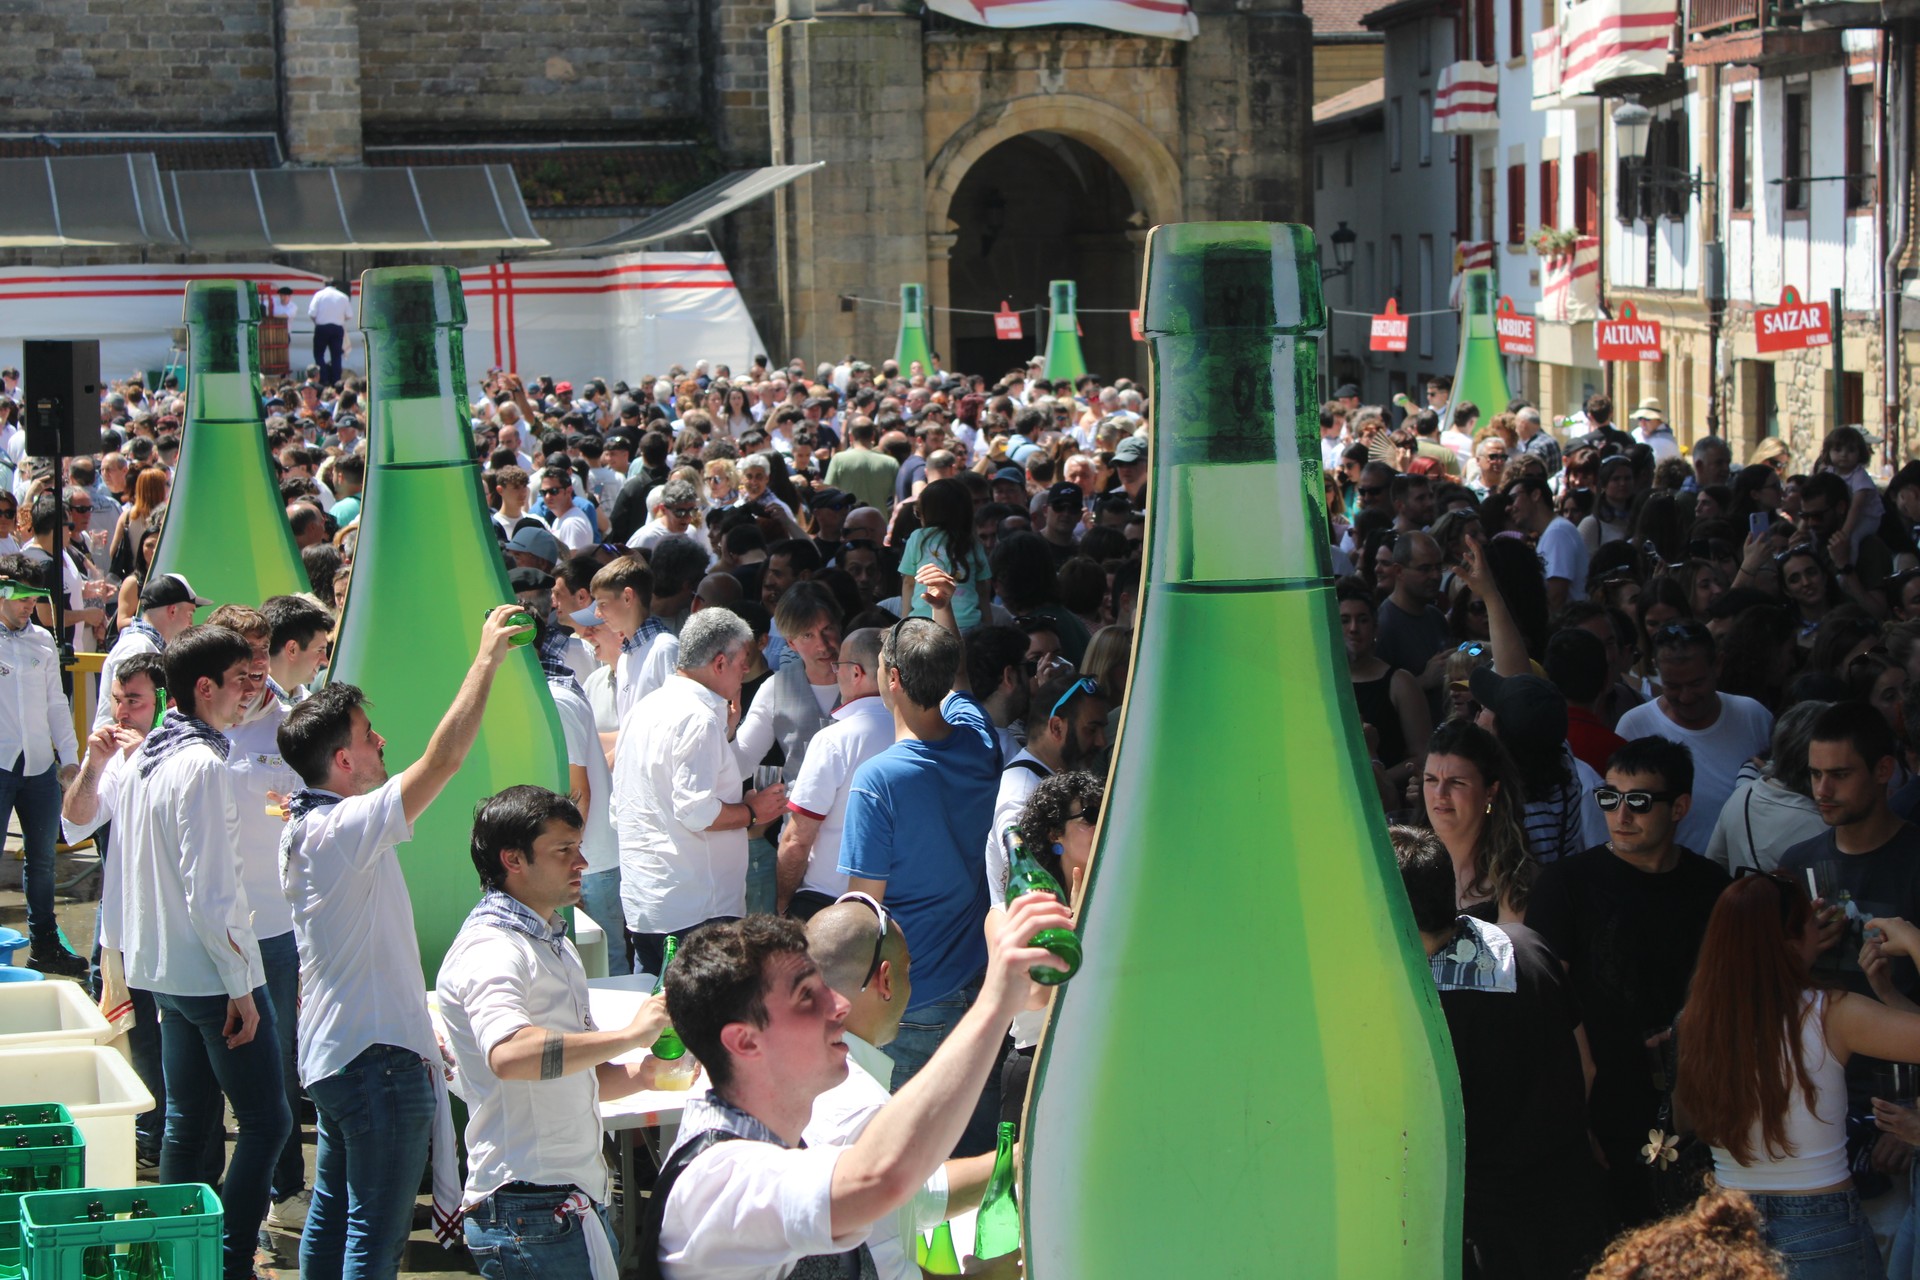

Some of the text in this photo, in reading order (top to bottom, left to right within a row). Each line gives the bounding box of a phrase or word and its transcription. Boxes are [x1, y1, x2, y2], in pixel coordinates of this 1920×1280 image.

[1496, 318, 1533, 339] ARBIDE
[1763, 307, 1821, 335] SAIZAR
[1602, 325, 1656, 345] ALTUNA
